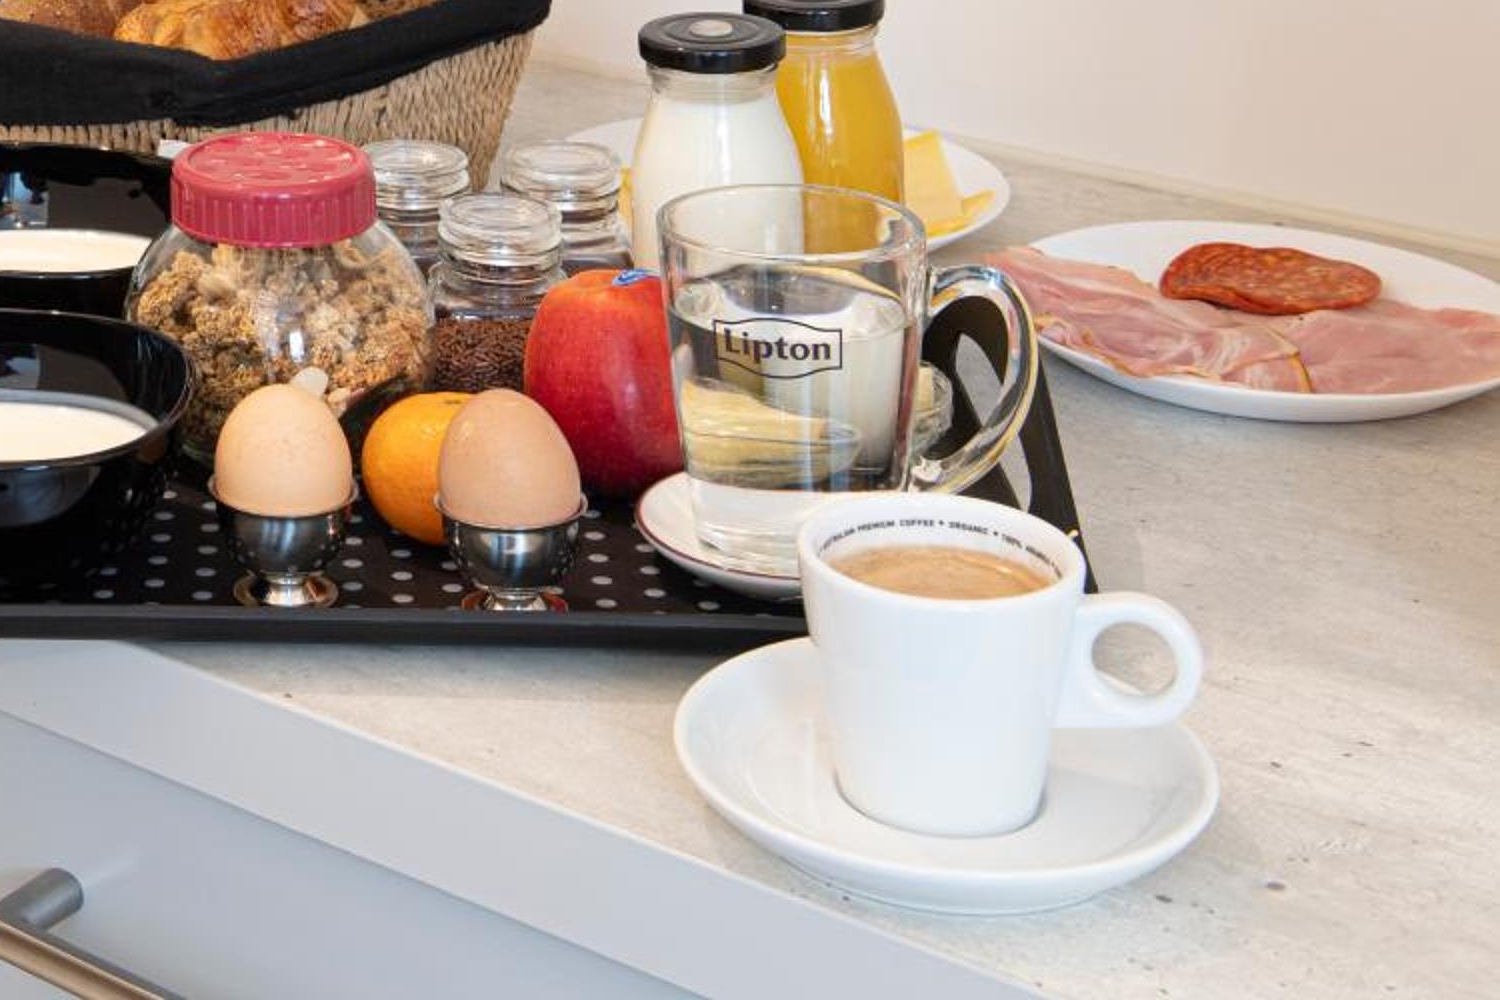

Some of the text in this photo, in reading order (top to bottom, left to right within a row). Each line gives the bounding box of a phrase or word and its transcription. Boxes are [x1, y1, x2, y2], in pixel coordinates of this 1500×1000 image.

[724, 327, 831, 364] Lipton
[899, 519, 935, 527] COFFEE
[948, 520, 989, 535] ORGANIC
